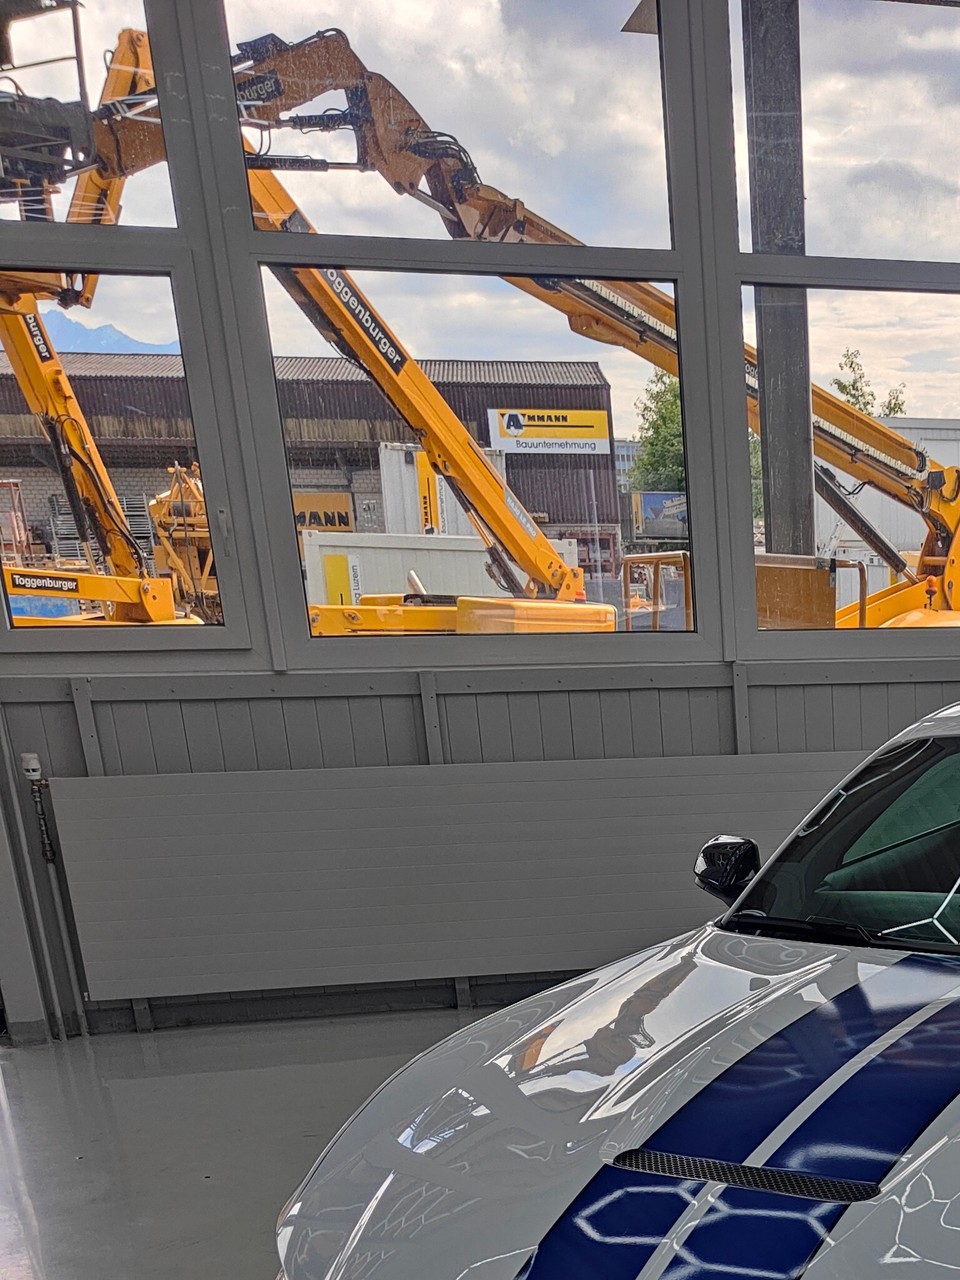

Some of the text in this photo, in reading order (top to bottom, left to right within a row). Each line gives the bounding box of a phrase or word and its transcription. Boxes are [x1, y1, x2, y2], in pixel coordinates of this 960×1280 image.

[25, 313, 50, 358] burger
[515, 440, 596, 451] Bauunternehmung
[13, 574, 77, 590] Toggenburger
[351, 564, 360, 591] Luzern
